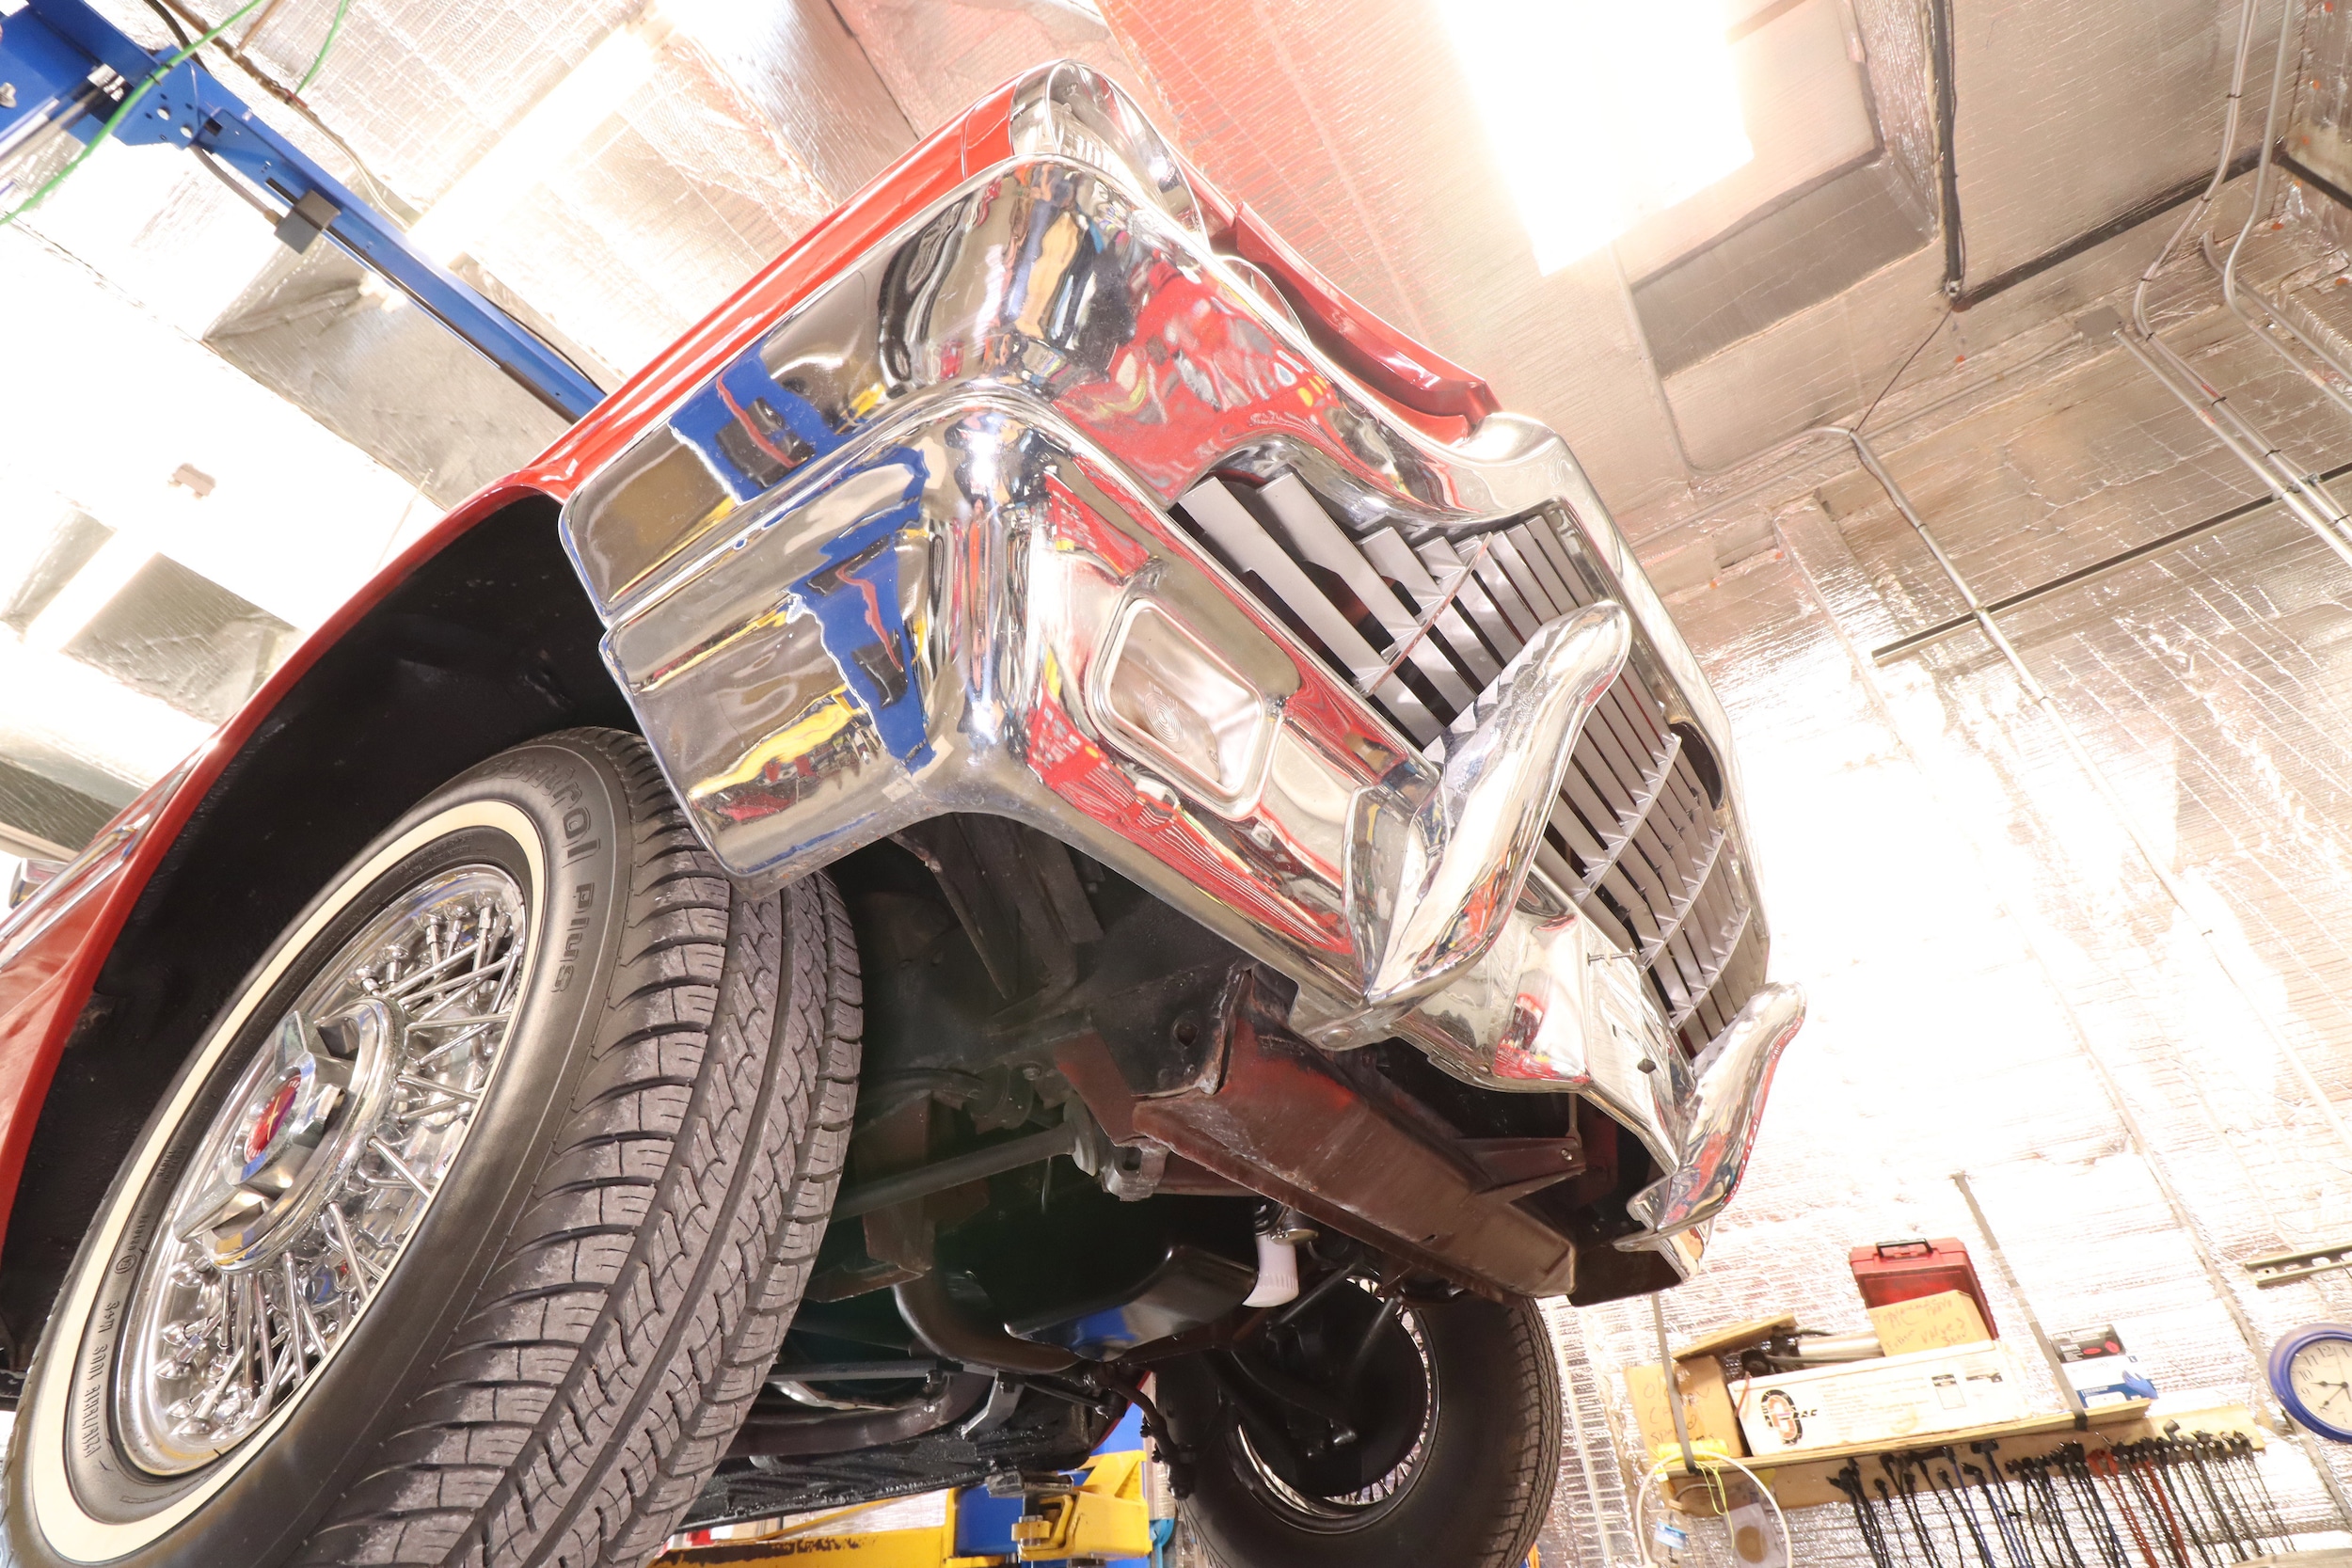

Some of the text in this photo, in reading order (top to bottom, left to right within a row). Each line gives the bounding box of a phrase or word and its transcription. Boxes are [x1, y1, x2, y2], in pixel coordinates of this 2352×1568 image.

[2317, 1345, 2335, 1358] 12
[2342, 1347, 2350, 1358] 1
[2304, 1354, 2319, 1367] 11
[2298, 1369, 2313, 1382] 10
[2301, 1386, 2312, 1399] 9
